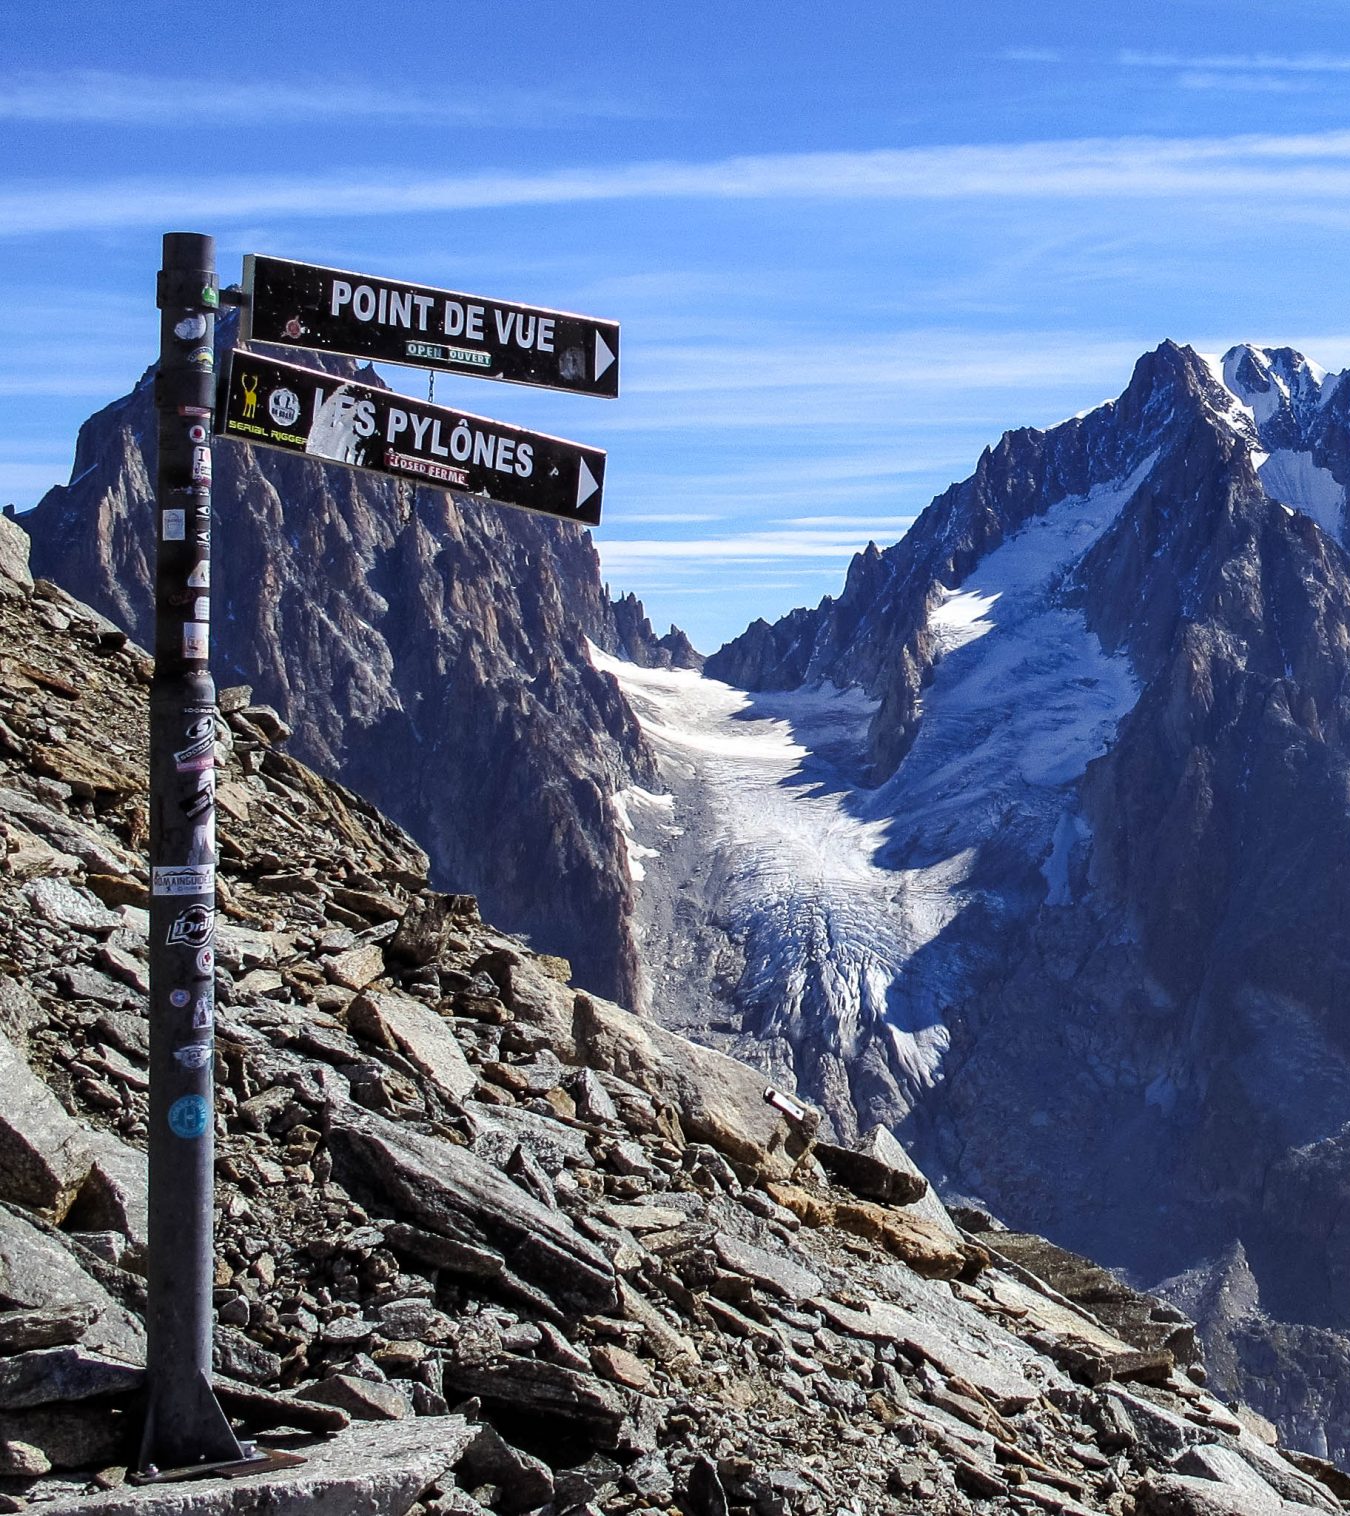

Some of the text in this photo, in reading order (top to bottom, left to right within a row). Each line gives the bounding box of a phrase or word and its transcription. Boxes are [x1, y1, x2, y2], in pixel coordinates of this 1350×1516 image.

[331, 280, 555, 352] POINT DE VUE
[407, 343, 490, 364] OPEN OUVERT
[228, 419, 268, 437] SERIAL
[386, 407, 534, 478] PYLÔNES
